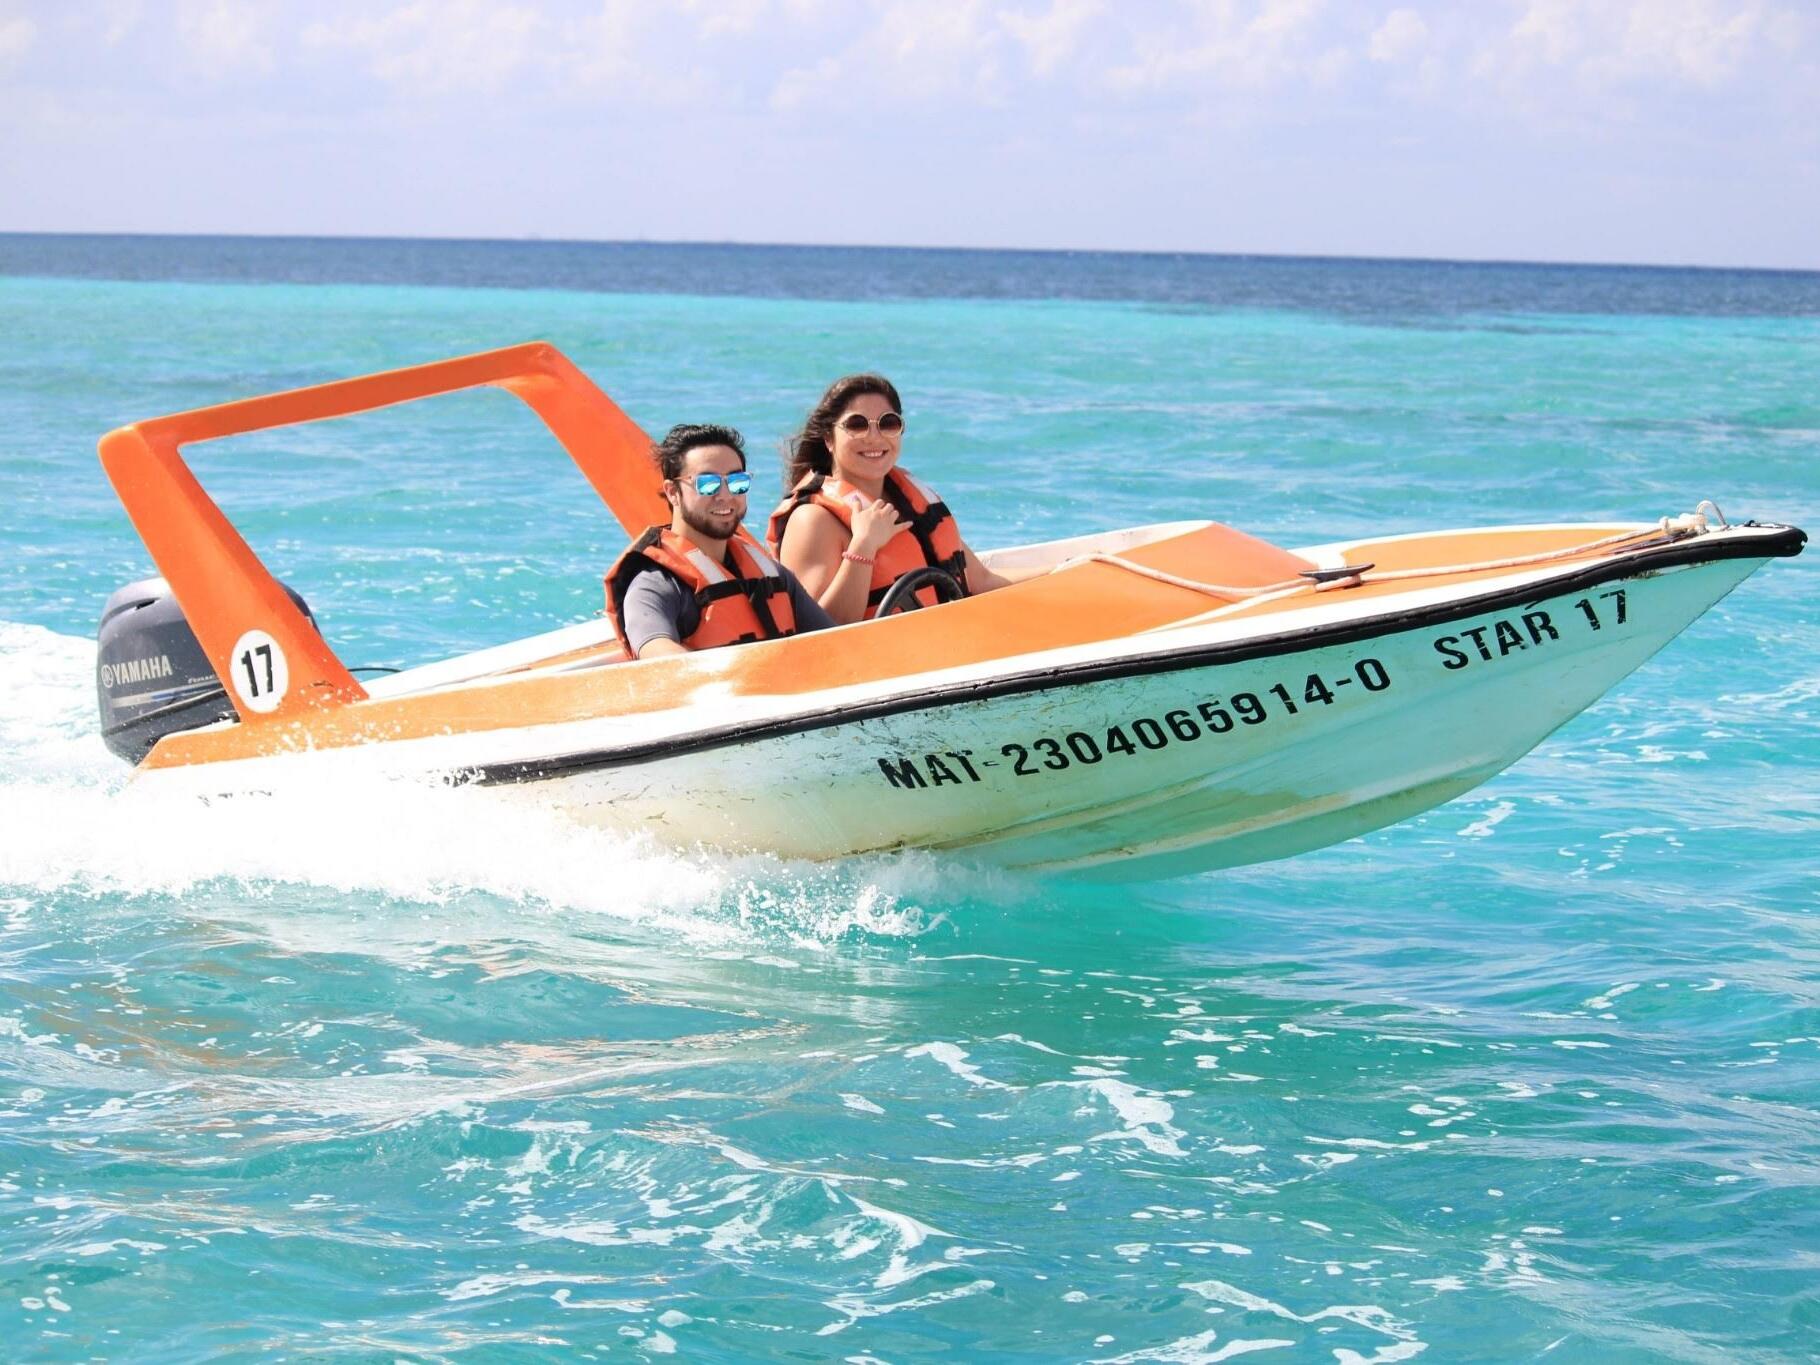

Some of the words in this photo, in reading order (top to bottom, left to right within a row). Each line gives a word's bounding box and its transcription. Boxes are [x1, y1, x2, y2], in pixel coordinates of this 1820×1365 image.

[1433, 611, 1560, 670] STAR
[1574, 589, 1627, 632] 17
[111, 655, 173, 685] YAMAHA
[240, 644, 274, 698] 17
